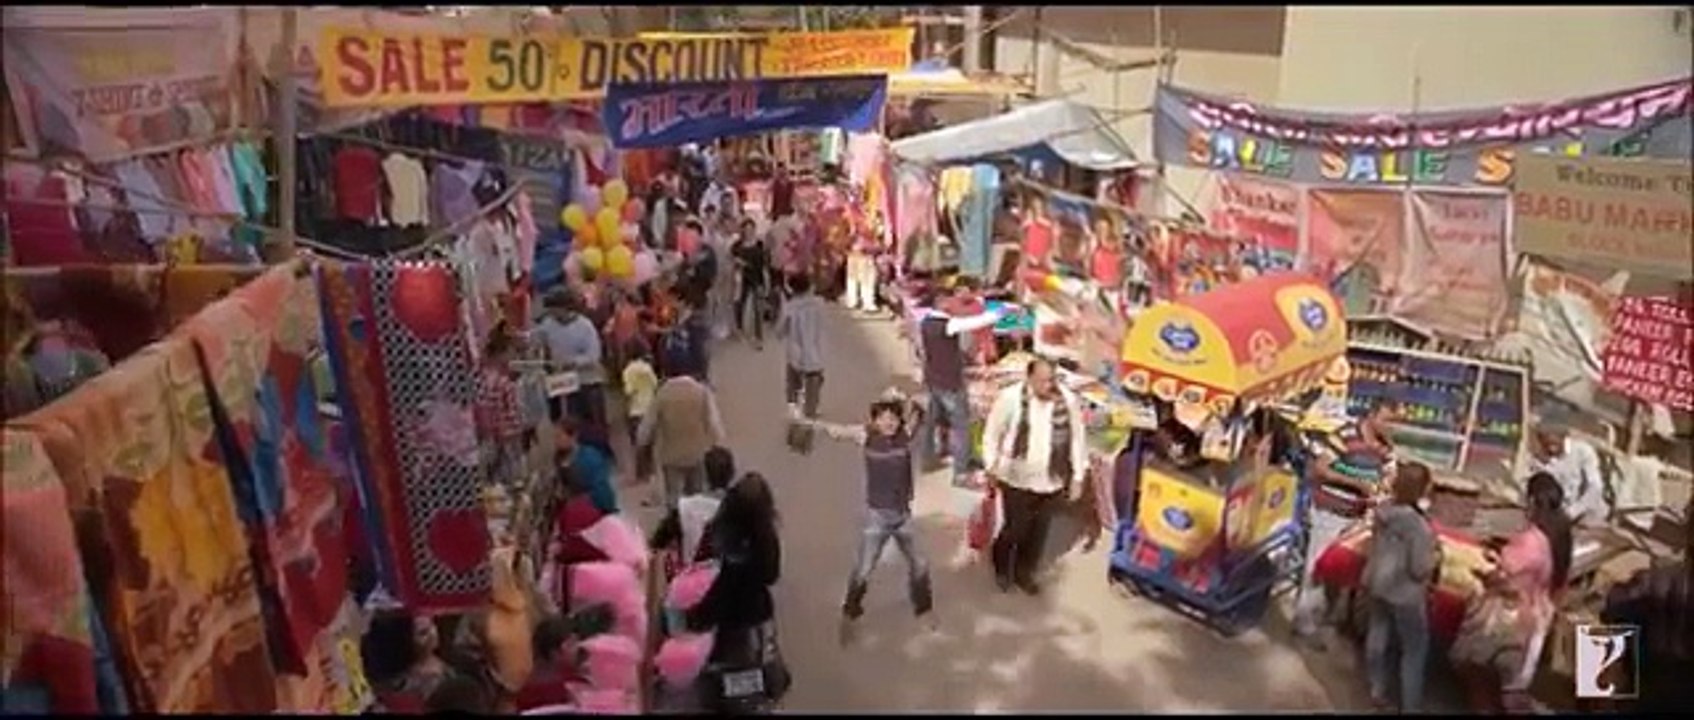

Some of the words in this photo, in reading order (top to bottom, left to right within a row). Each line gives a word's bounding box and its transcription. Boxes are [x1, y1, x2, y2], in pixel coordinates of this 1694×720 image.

[337, 36, 470, 97] SALE
[580, 36, 769, 91] DISCOUNT
[1187, 126, 1295, 178] SALE
[1318, 140, 1451, 184] SALE
[1556, 164, 1656, 193] Welcome
[1515, 190, 1596, 224] BABU
[1605, 354, 1672, 387] PANEER
